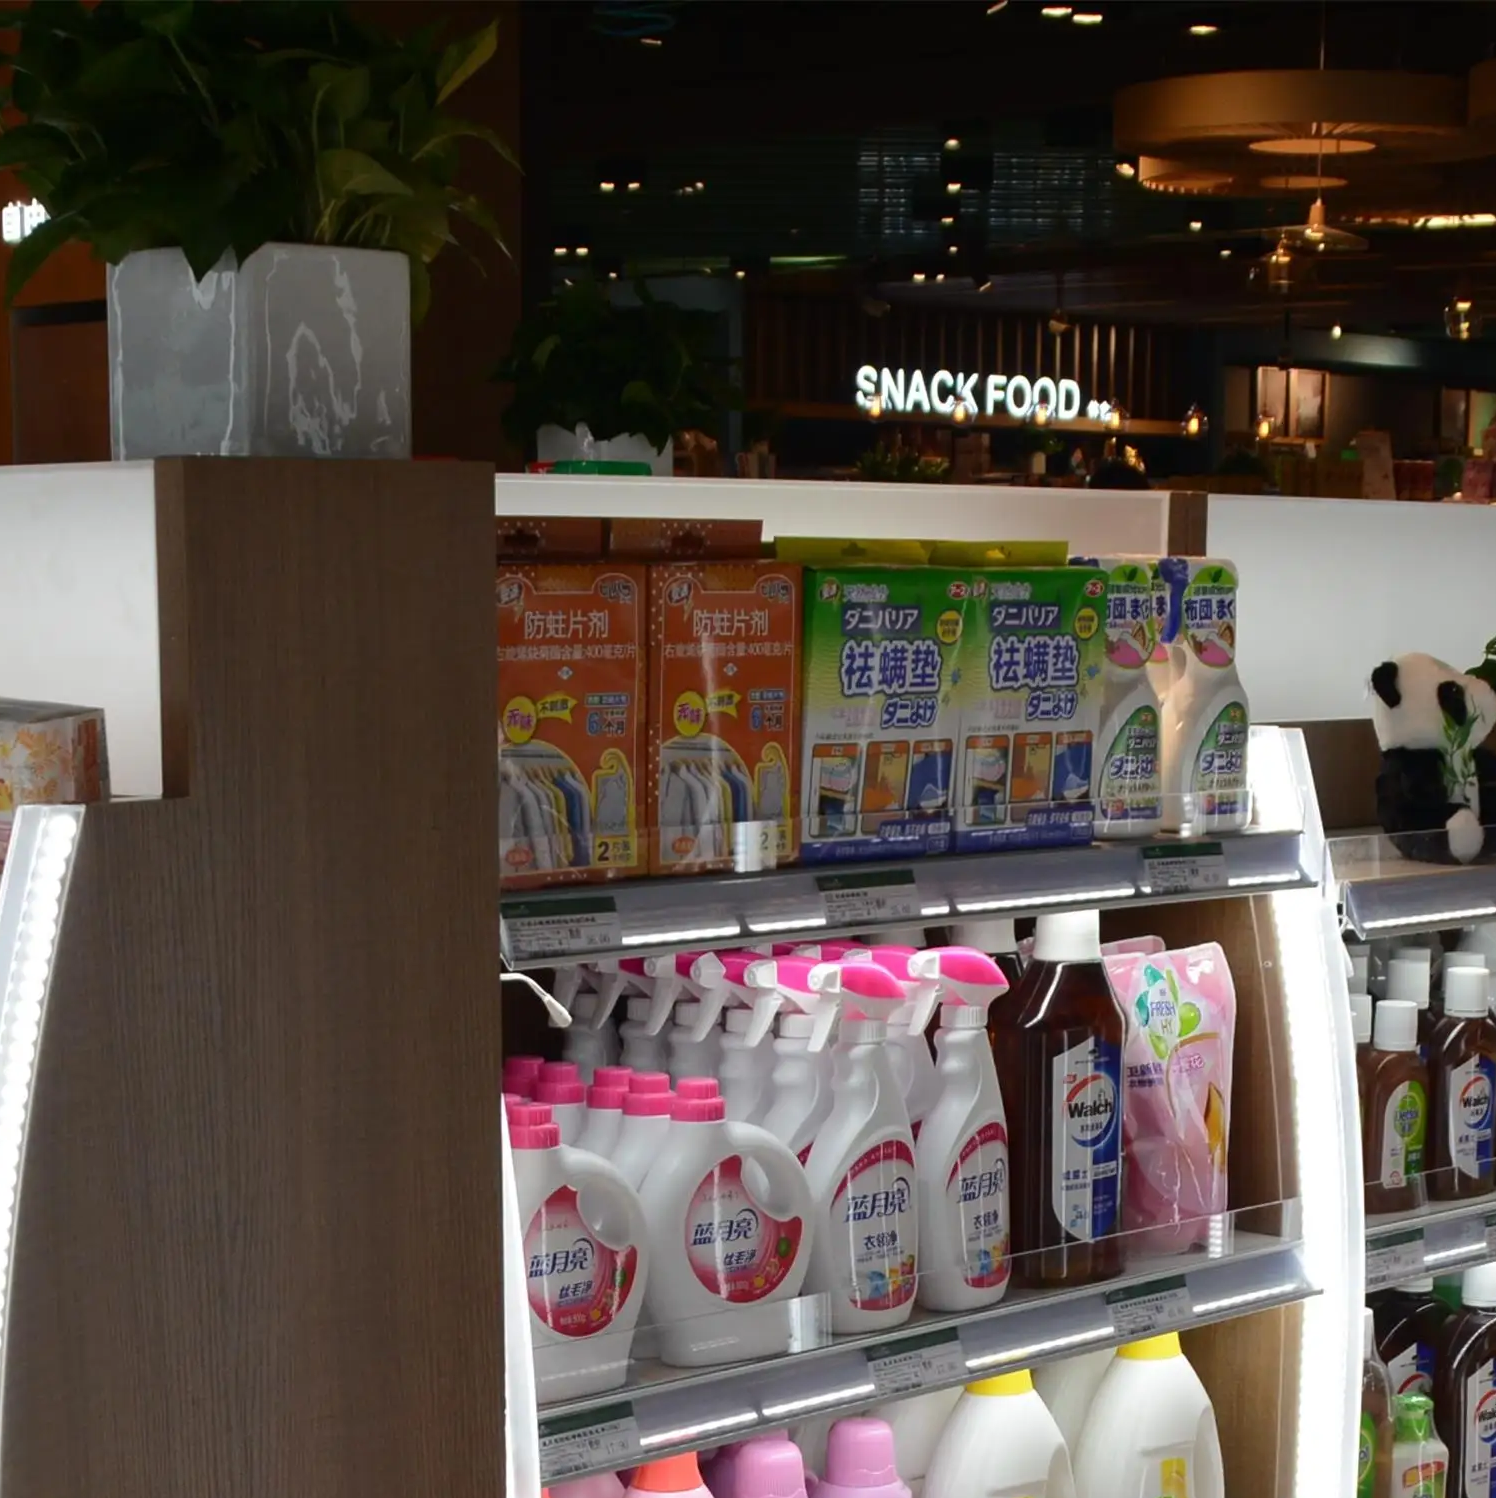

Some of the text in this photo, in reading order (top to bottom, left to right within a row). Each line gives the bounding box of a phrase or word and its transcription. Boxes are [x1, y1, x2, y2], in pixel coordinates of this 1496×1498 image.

[856, 365, 979, 415] SNACK
[986, 374, 1081, 420] FOOD
[524, 609, 608, 640] 防蛀片剂
[693, 609, 769, 638] 防蛀片剂
[844, 607, 919, 631] ダニバリア
[992, 605, 1060, 628] ダニバリア
[844, 644, 940, 690] 祛螨垫
[992, 638, 1078, 688] 祛螨垫
[1149, 1001, 1177, 1017] FRESH
[1068, 1095, 1114, 1119] Walch
[845, 1186, 908, 1223] 蓝月亮
[691, 1216, 757, 1247] 蓝月亮
[528, 1243, 593, 1279] 蓝月亮
